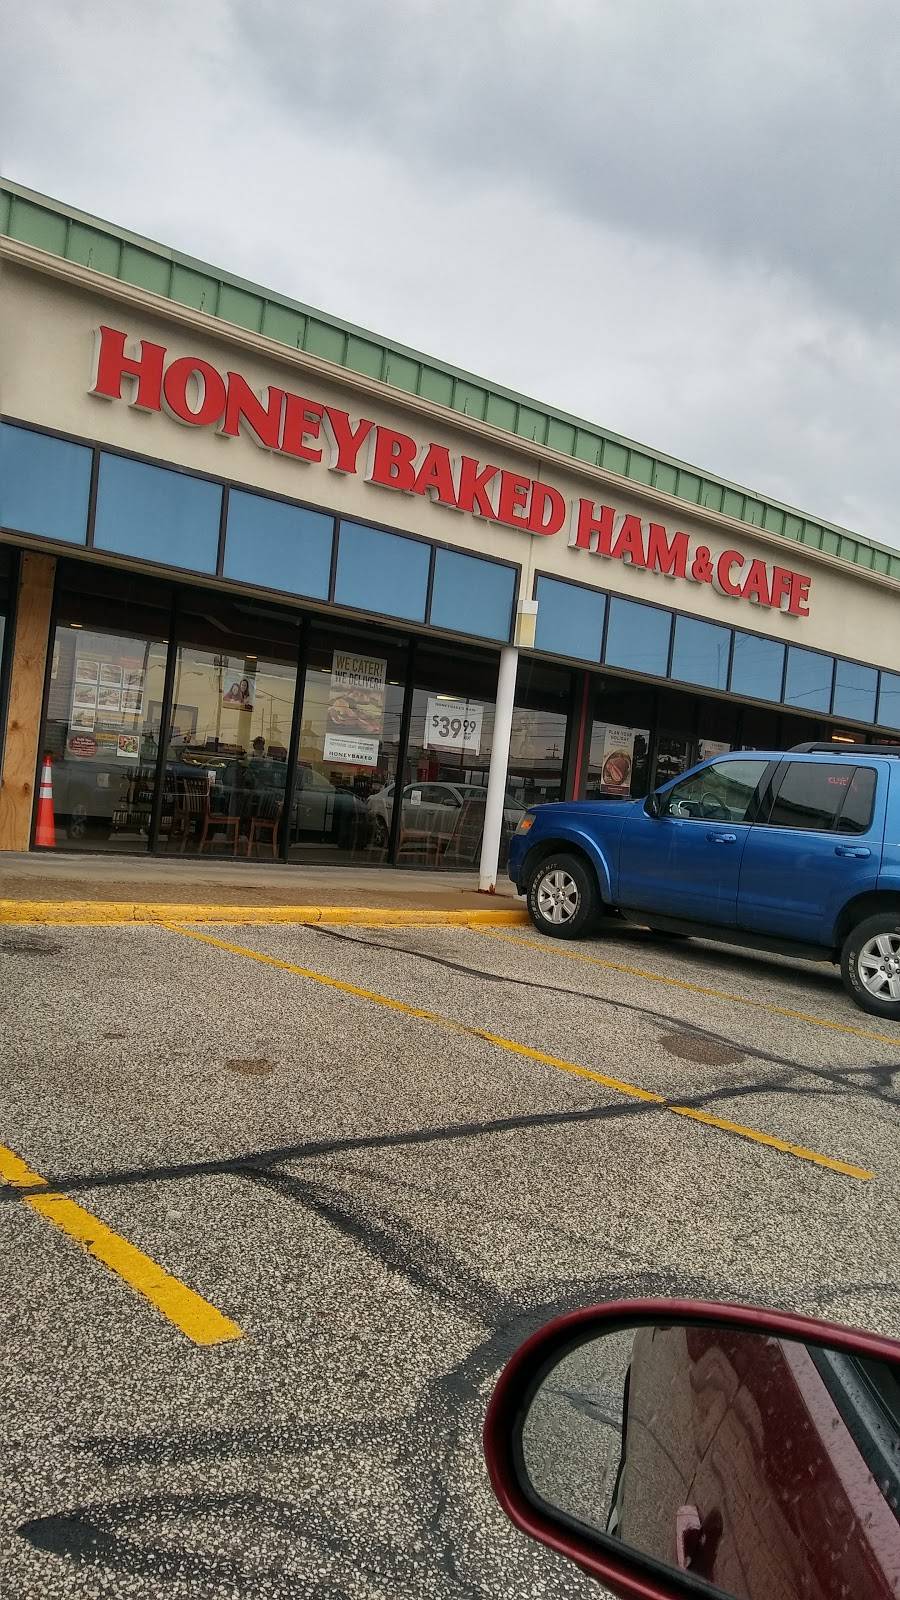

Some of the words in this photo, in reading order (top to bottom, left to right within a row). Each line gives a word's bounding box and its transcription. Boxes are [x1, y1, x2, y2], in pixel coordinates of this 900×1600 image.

[90, 325, 566, 536] HONEYBAKED
[336, 655, 352, 671] WE
[352, 658, 384, 676] CATER!
[335, 670, 347, 684] WE
[348, 673, 382, 690] DELIVER!
